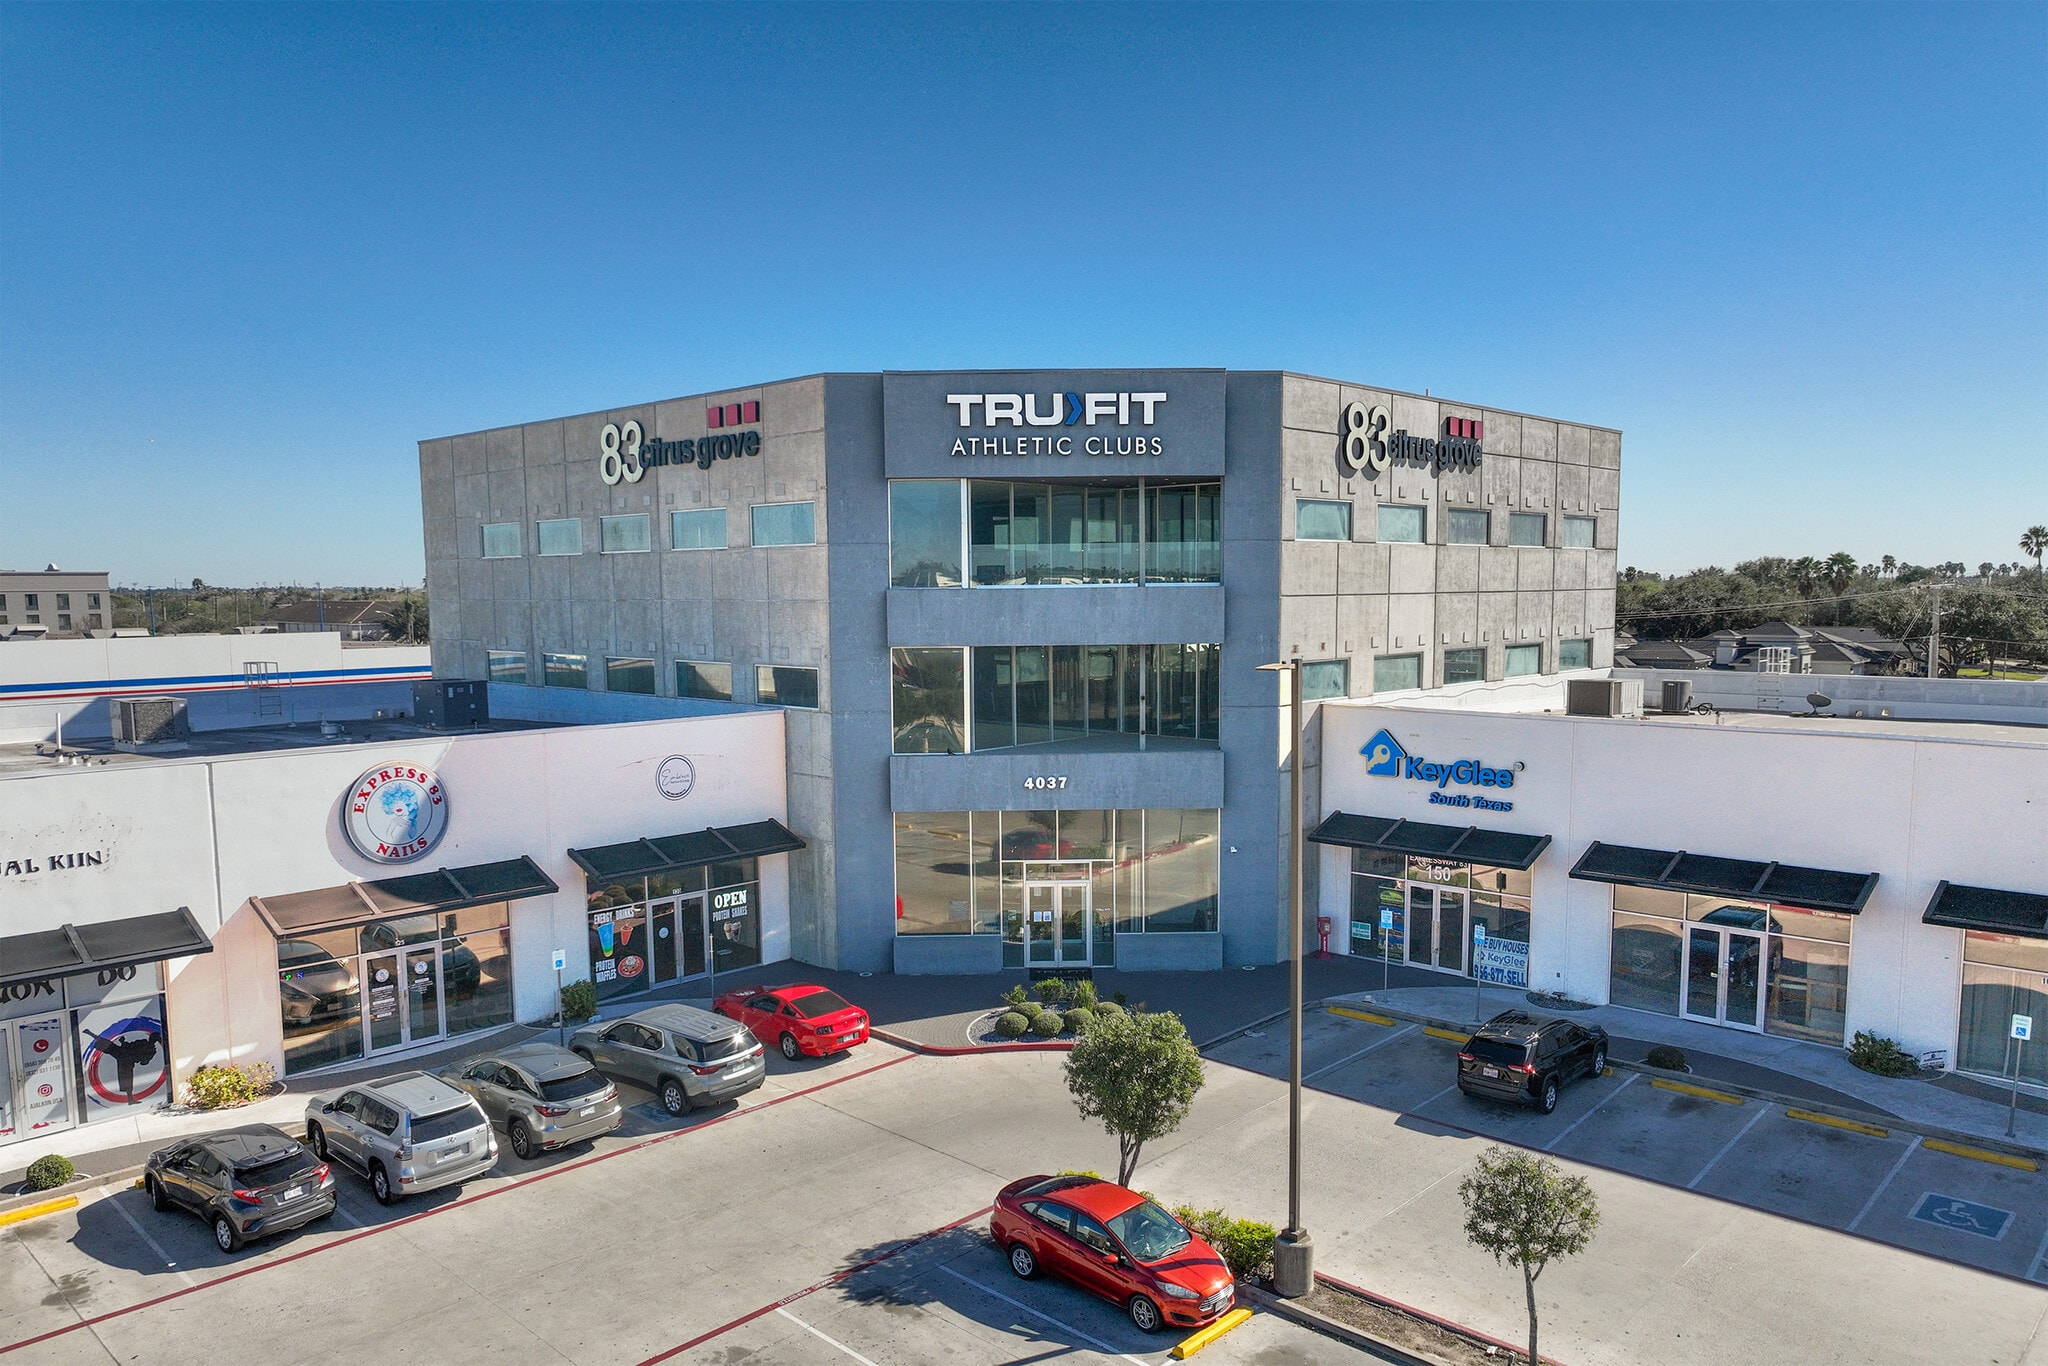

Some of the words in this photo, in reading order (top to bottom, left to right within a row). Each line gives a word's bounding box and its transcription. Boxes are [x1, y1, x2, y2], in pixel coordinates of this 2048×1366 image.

[951, 437, 1072, 456] ATHLETIC
[1085, 437, 1163, 456] CLUBS
[1344, 401, 1393, 473] 83
[1387, 429, 1437, 463] citrus
[1436, 438, 1483, 471] grove
[600, 420, 645, 486] 83
[638, 438, 695, 468] citrus
[697, 431, 760, 470] grove
[1405, 756, 1514, 789] KeyGlee
[353, 767, 428, 814] EXPRESS
[429, 785, 442, 805] 83
[1023, 776, 1068, 790] 4037
[1428, 792, 1470, 808] South
[1472, 796, 1513, 812] Texas
[376, 837, 428, 858] NAILS
[0, 858, 40, 877] AL
[50, 850, 103, 872] KIIN
[1426, 865, 1451, 882] 150
[714, 890, 747, 909] OPEN
[593, 911, 613, 925] ENERGY
[615, 907, 635, 921] DRINKS
[712, 909, 730, 922] PROTEIN
[731, 906, 748, 918] SHAKES
[1488, 938, 1502, 951] BUY
[1502, 940, 1530, 955] HOUSES
[595, 958, 616, 972] PROTEIN
[1487, 952, 1525, 967] KeyGlee
[595, 969, 617, 983] WAFFLES
